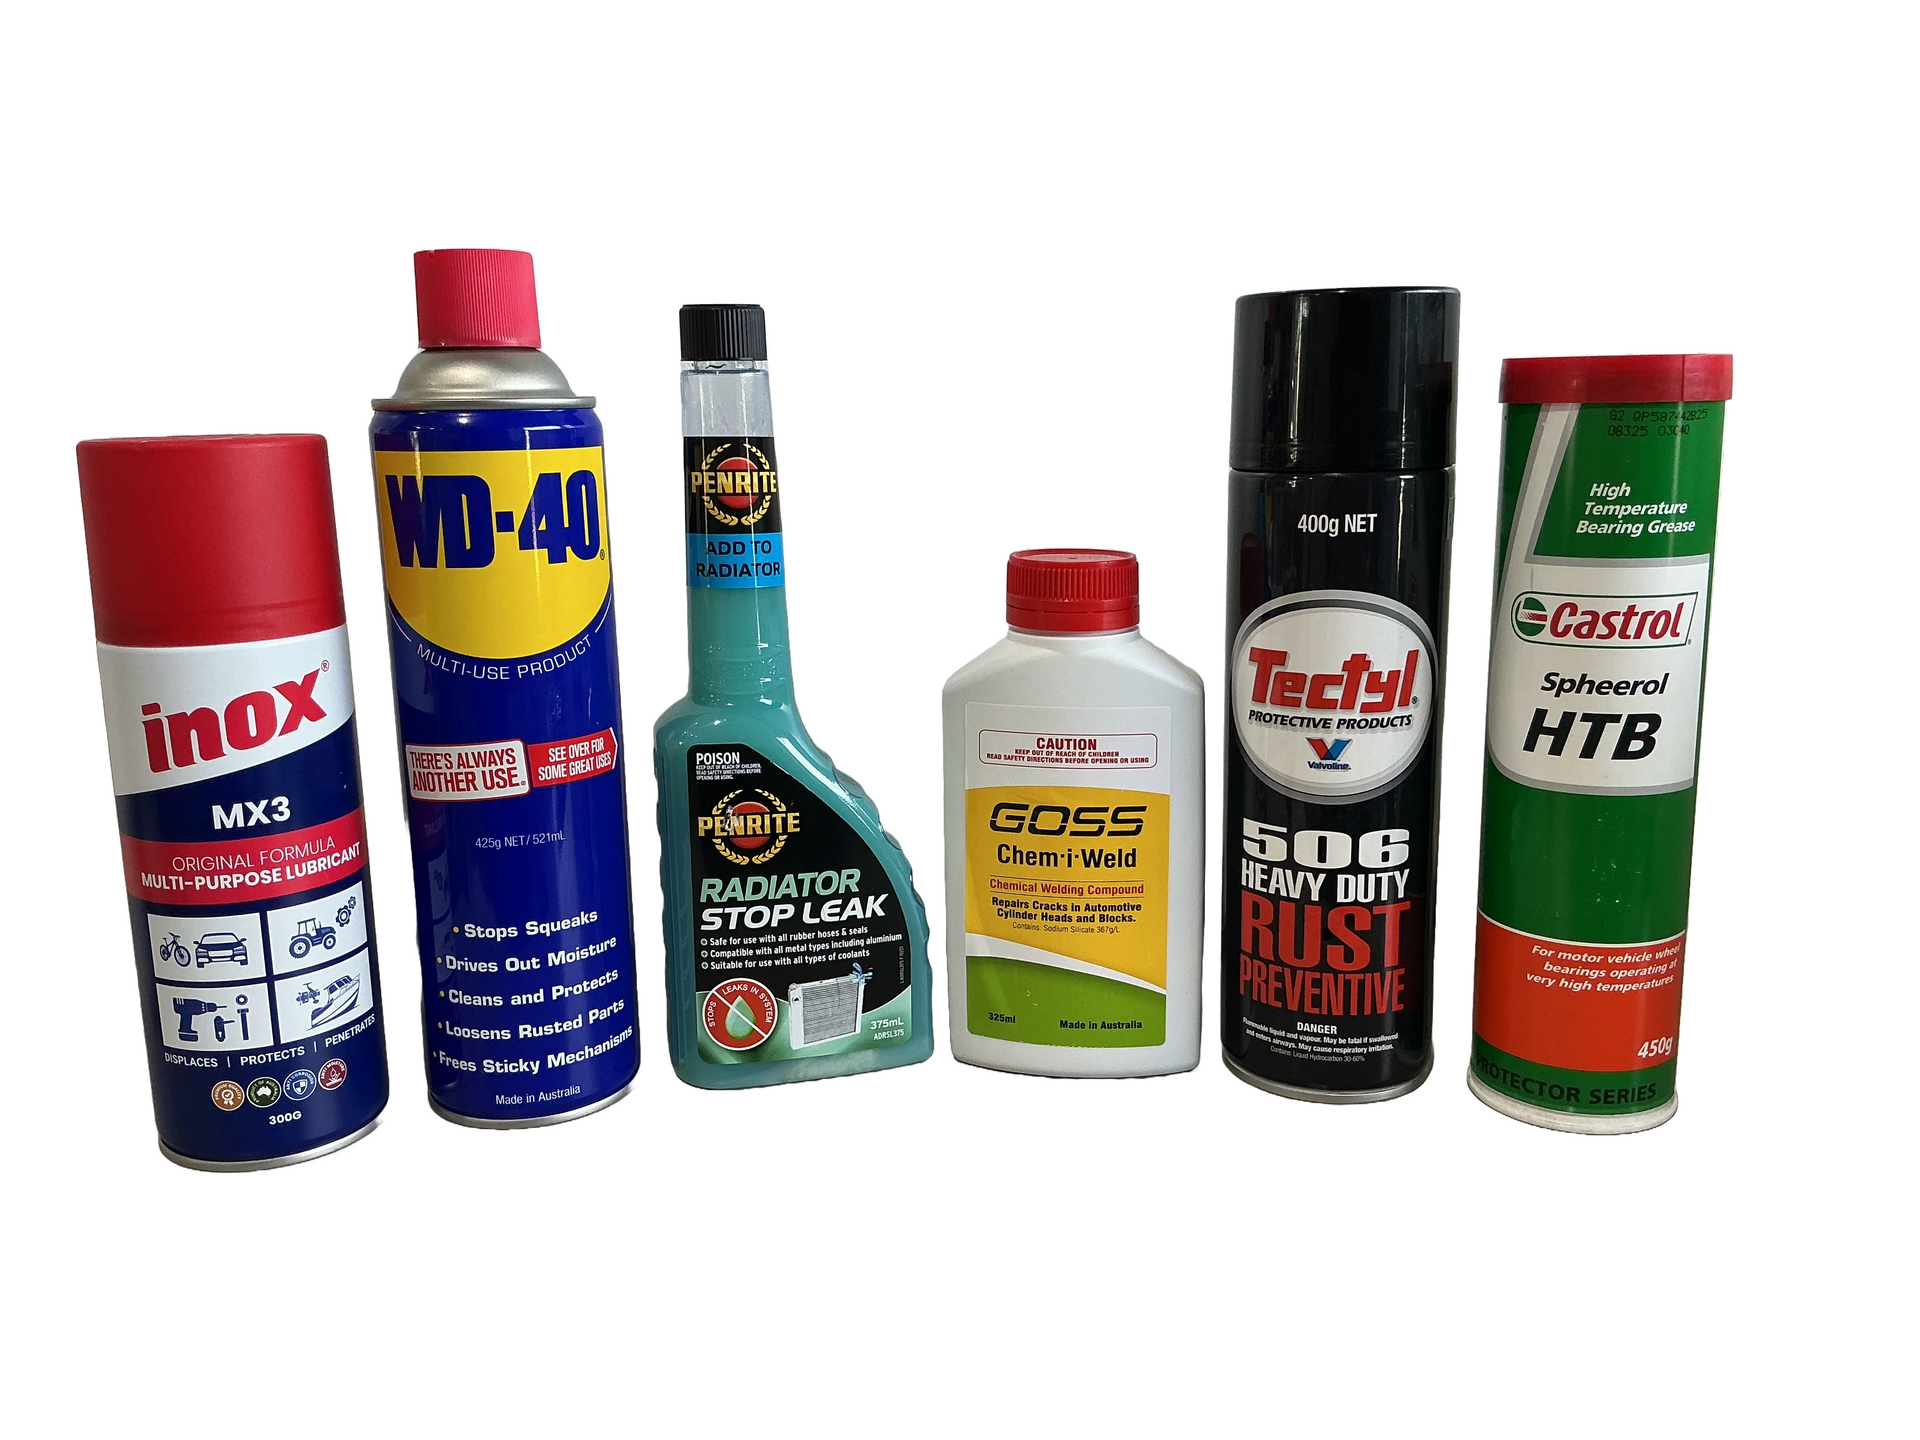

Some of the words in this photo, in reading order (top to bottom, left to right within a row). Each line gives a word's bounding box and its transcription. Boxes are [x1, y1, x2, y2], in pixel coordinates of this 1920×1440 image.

[1608, 425, 1649, 437] 08325
[691, 471, 777, 494] PENRITE
[1589, 483, 1631, 500] High
[385, 470, 601, 569] WD-40
[1584, 501, 1688, 519] Temperature
[1297, 514, 1339, 537] 400g
[1344, 513, 1378, 533] NET
[1576, 520, 1643, 537] Bearing
[1647, 520, 1696, 534] Grease
[705, 541, 746, 556] ADD
[750, 540, 772, 555] TO
[696, 561, 781, 578] RADIATOR
[1549, 601, 1685, 640] Castrol
[417, 643, 510, 680] MULTI-USE
[517, 634, 591, 678] PRODUCT
[1248, 646, 1420, 714] Tectyl
[1540, 671, 1670, 698] Spheerol
[141, 668, 328, 773] inox
[1248, 709, 1333, 729] PROTECTIVE
[1336, 714, 1413, 730] PRODUCTS
[1036, 737, 1097, 750] CAUTION
[1522, 707, 1663, 761] HTB
[409, 751, 454, 770] THERE'S
[457, 747, 517, 769] ALWAYS
[549, 747, 567, 763] SEE
[568, 741, 591, 759] OVER
[591, 737, 605, 753] FOR
[696, 751, 740, 765] POISON
[1003, 754, 1026, 762] SAFETY
[1026, 755, 1064, 763] DIRECTIONS
[538, 764, 567, 781] SOME
[569, 757, 594, 776] GREAT
[595, 751, 612, 770] USES
[412, 771, 478, 793] ANOTHER
[212, 796, 291, 829] MX3
[698, 812, 800, 837] PENRITE
[989, 802, 1148, 837] GOSS
[475, 837, 502, 850] 425g
[532, 830, 566, 844] 521mL
[1243, 818, 1410, 869] 506
[172, 852, 255, 871] ORIGINAL
[260, 836, 335, 865] FORMULA
[141, 867, 282, 891] MULTI-PURPOSE
[286, 841, 361, 880] LUBRICANT
[700, 868, 861, 903] RADIATOR
[989, 878, 1037, 893] Chemical
[1040, 883, 1084, 897] Welding
[1087, 884, 1144, 896] Compound
[1241, 858, 1326, 901] HEAVY
[1337, 869, 1410, 903] DUTY
[700, 903, 795, 931] STOP
[802, 893, 889, 924] LEAK
[992, 896, 1030, 910] Repairs
[1032, 900, 1068, 911] Cracks
[1070, 902, 1081, 912] in
[1084, 903, 1142, 912] Automotive
[997, 908, 1038, 921] Cylinder
[1041, 912, 1073, 923] Heads
[1076, 914, 1096, 923] and
[1099, 913, 1137, 923] Blocks.
[464, 924, 518, 942] Stops
[525, 910, 598, 937] Squeaks
[709, 937, 727, 946] Safe
[729, 936, 741, 945] for
[759, 934, 776, 944] with
[778, 933, 788, 942] all
[789, 931, 816, 941] rubber
[817, 930, 840, 939] hoses
[841, 927, 847, 936] &
[849, 925, 868, 935] seals
[1012, 921, 1041, 931] Contains:
[1043, 924, 1069, 933] Sodium
[1070, 926, 1094, 934] Silicate
[1096, 926, 1120, 934] 367g/L
[1241, 889, 1411, 971] RUST
[446, 955, 499, 973] Drives
[505, 958, 541, 972] Out
[547, 936, 617, 967] Moisture
[710, 948, 754, 959] Compatible
[755, 946, 773, 956] with
[774, 944, 784, 954] all
[785, 943, 807, 953] metal
[808, 942, 830, 952] types
[831, 938, 865, 949] including
[866, 933, 902, 945] aluminium
[1531, 944, 1555, 957] For
[1557, 951, 1605, 964] motor
[1607, 952, 1653, 964] vehicle
[1655, 942, 1681, 959] wheel
[710, 961, 743, 970] Suitable
[744, 959, 757, 968] for
[774, 957, 792, 966] with
[793, 956, 803, 965] all
[805, 954, 826, 965] types
[828, 952, 836, 961] of
[838, 949, 870, 960] coolants
[1543, 961, 1607, 978] bearings
[1609, 962, 1667, 979] operating
[1669, 958, 1678, 970] at
[448, 989, 503, 1006] Cleans
[510, 989, 544, 1005] and
[552, 969, 619, 1000] Protects
[1239, 954, 1405, 1016] PREVENTIVE
[1526, 972, 1556, 987] very
[1559, 978, 1592, 993] high
[1596, 975, 1674, 994] temperatures
[707, 1001, 717, 1027] STOPS
[722, 984, 748, 995] LEAKS
[750, 986, 760, 995] IN
[759, 992, 773, 1023] SYSTEM
[446, 1021, 511, 1040] Loosens
[518, 1014, 583, 1039] Rusted
[588, 999, 625, 1024] Parts
[870, 1018, 904, 1030] 375mL
[988, 1012, 1016, 1024] 325ml
[1059, 1019, 1086, 1029] Made
[1088, 1019, 1098, 1029] in
[1100, 1019, 1143, 1029] Australia
[1297, 1021, 1338, 1035] DANGER
[164, 1052, 218, 1068] DISPLACES
[240, 1046, 305, 1066] PROTECTS
[324, 1014, 375, 1048] PENETRATES
[873, 1029, 905, 1041] ADRSL375
[1637, 1035, 1673, 1059] 450g
[439, 1050, 477, 1072] Frees
[483, 1058, 540, 1075] Sticky
[547, 1025, 633, 1069] Mechanisms
[1474, 1053, 1581, 1104] PROTECTOR
[1589, 1082, 1657, 1105] SERIES
[495, 1094, 523, 1105] Made
[526, 1093, 535, 1103] in
[538, 1085, 581, 1102] Australia
[268, 1110, 302, 1125] 300G
